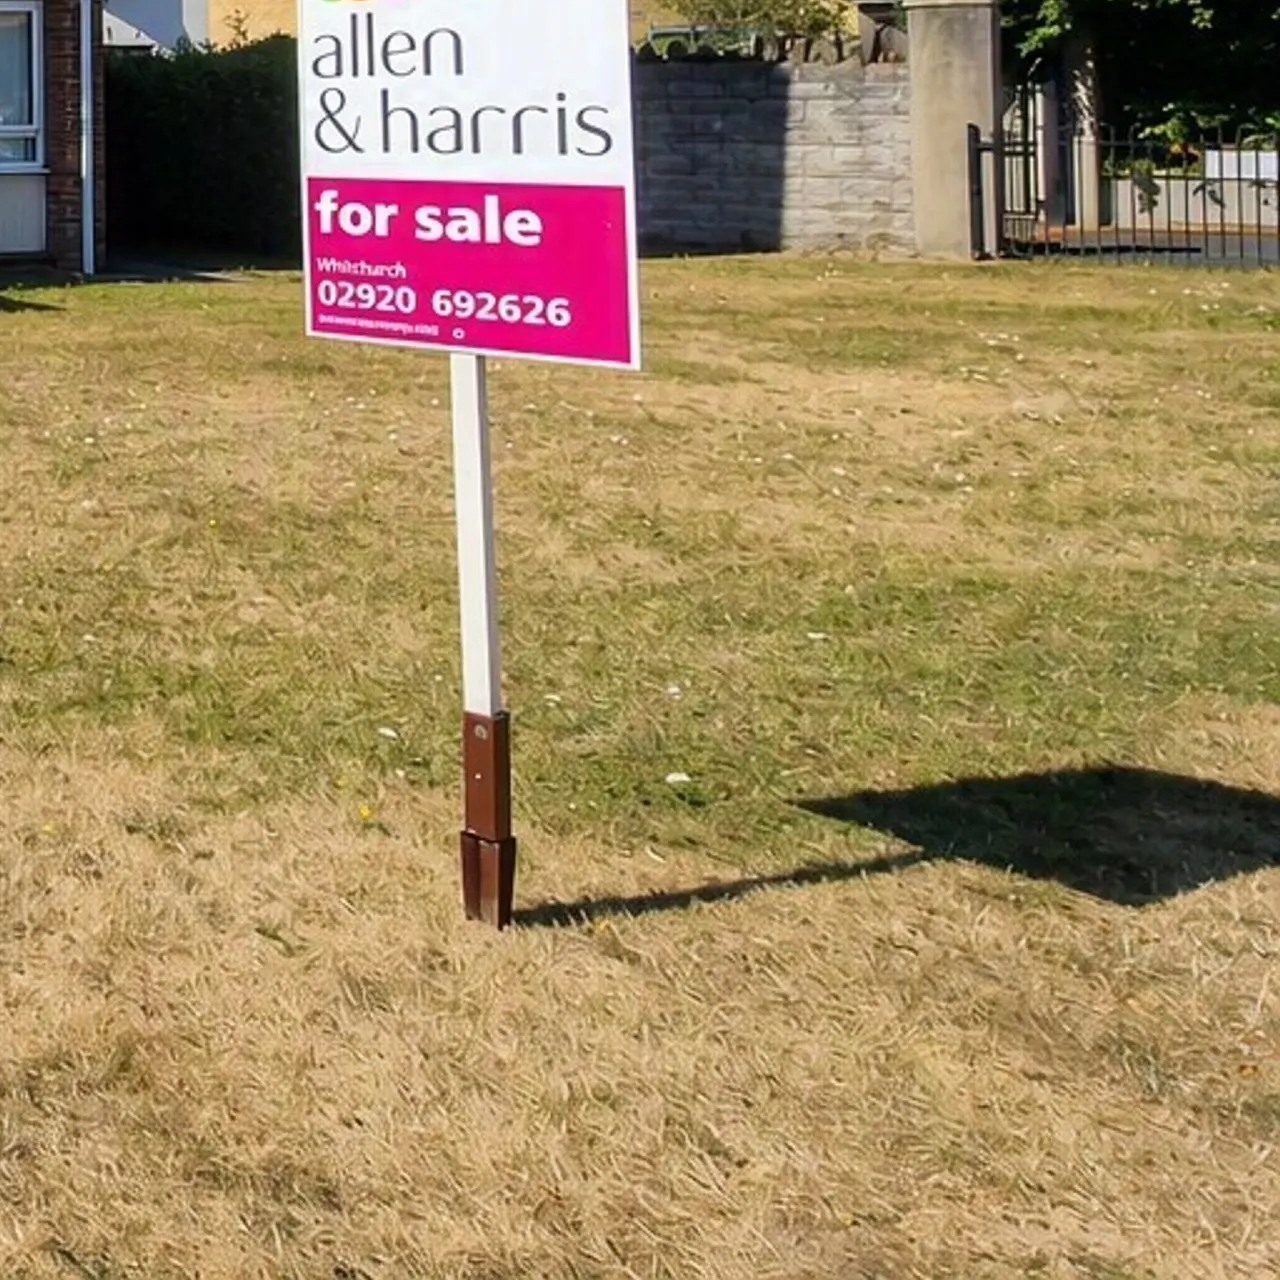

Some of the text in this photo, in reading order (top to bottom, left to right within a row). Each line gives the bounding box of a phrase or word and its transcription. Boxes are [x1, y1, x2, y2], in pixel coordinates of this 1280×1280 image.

[311, 12, 464, 78] allen
[314, 87, 613, 156] & harris
[314, 189, 543, 246] for sale
[317, 279, 416, 314] 02920
[431, 289, 571, 327] 692626
